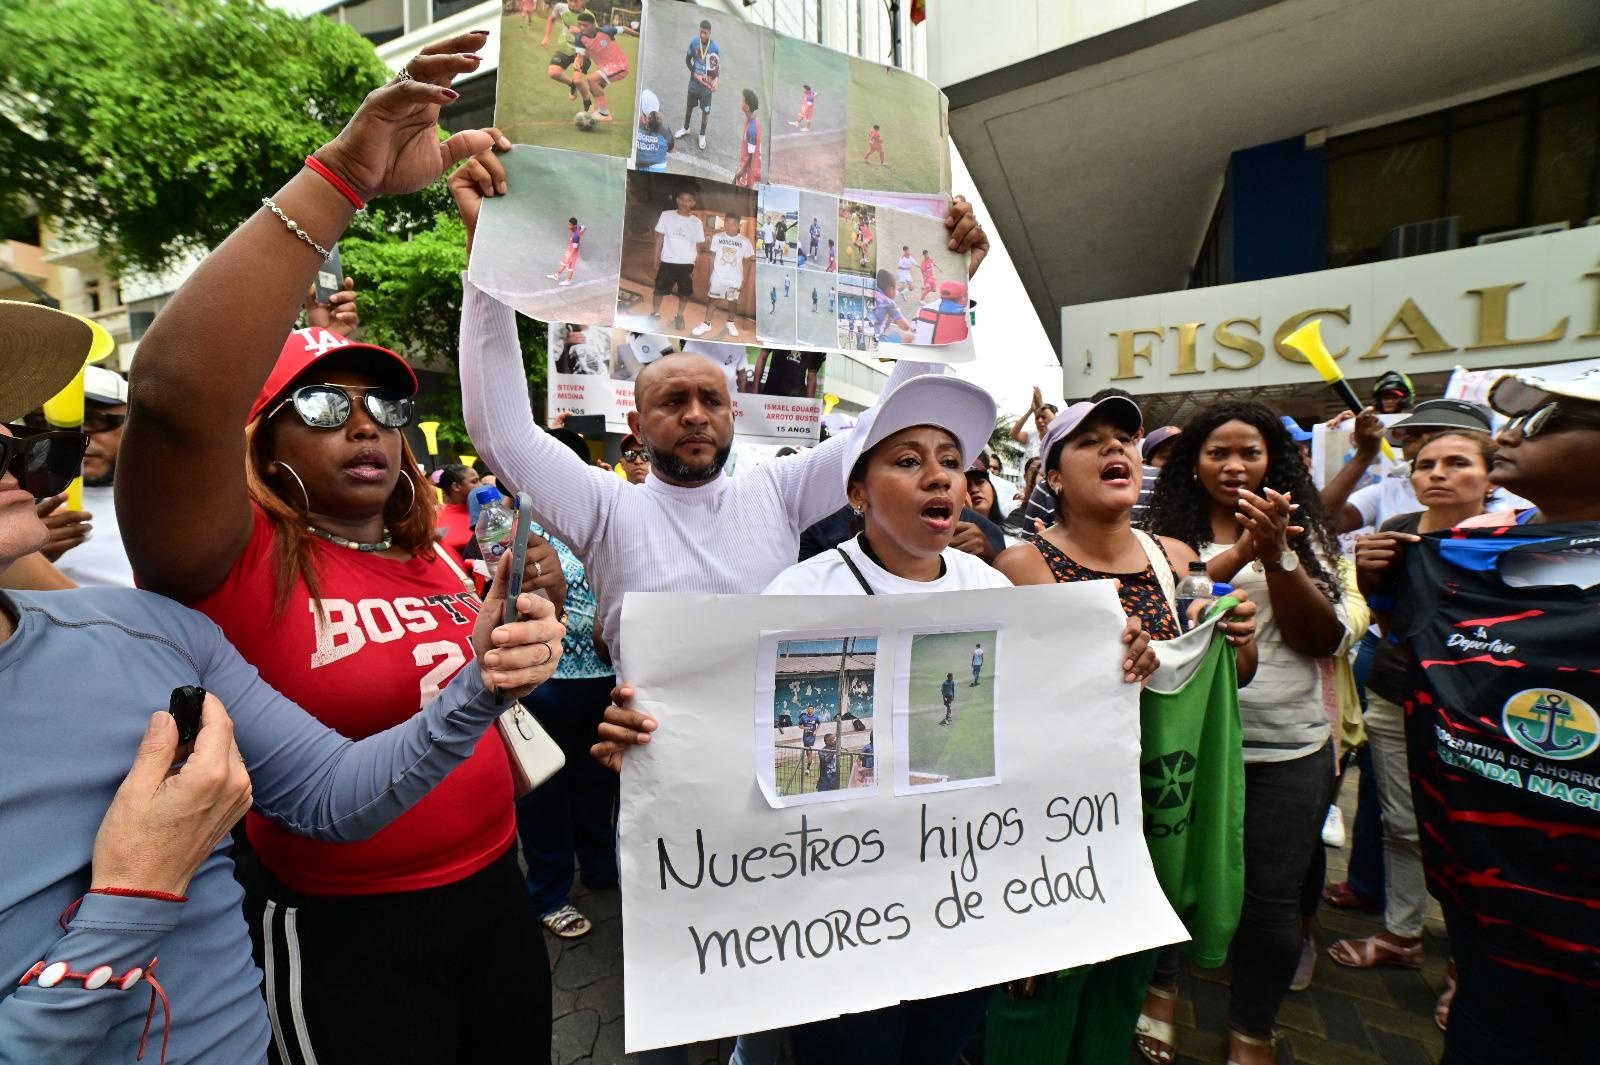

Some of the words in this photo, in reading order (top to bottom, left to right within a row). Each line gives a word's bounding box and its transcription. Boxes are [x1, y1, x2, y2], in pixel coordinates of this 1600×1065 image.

[292, 327, 350, 357] LA
[764, 403, 790, 412] ISMAEL
[766, 413, 793, 421] ARROYO
[1509, 754, 1530, 769] DE
[920, 803, 1025, 883] hijos
[1046, 791, 1120, 843] son
[934, 871, 985, 929] de
[1002, 845, 1107, 915] edad
